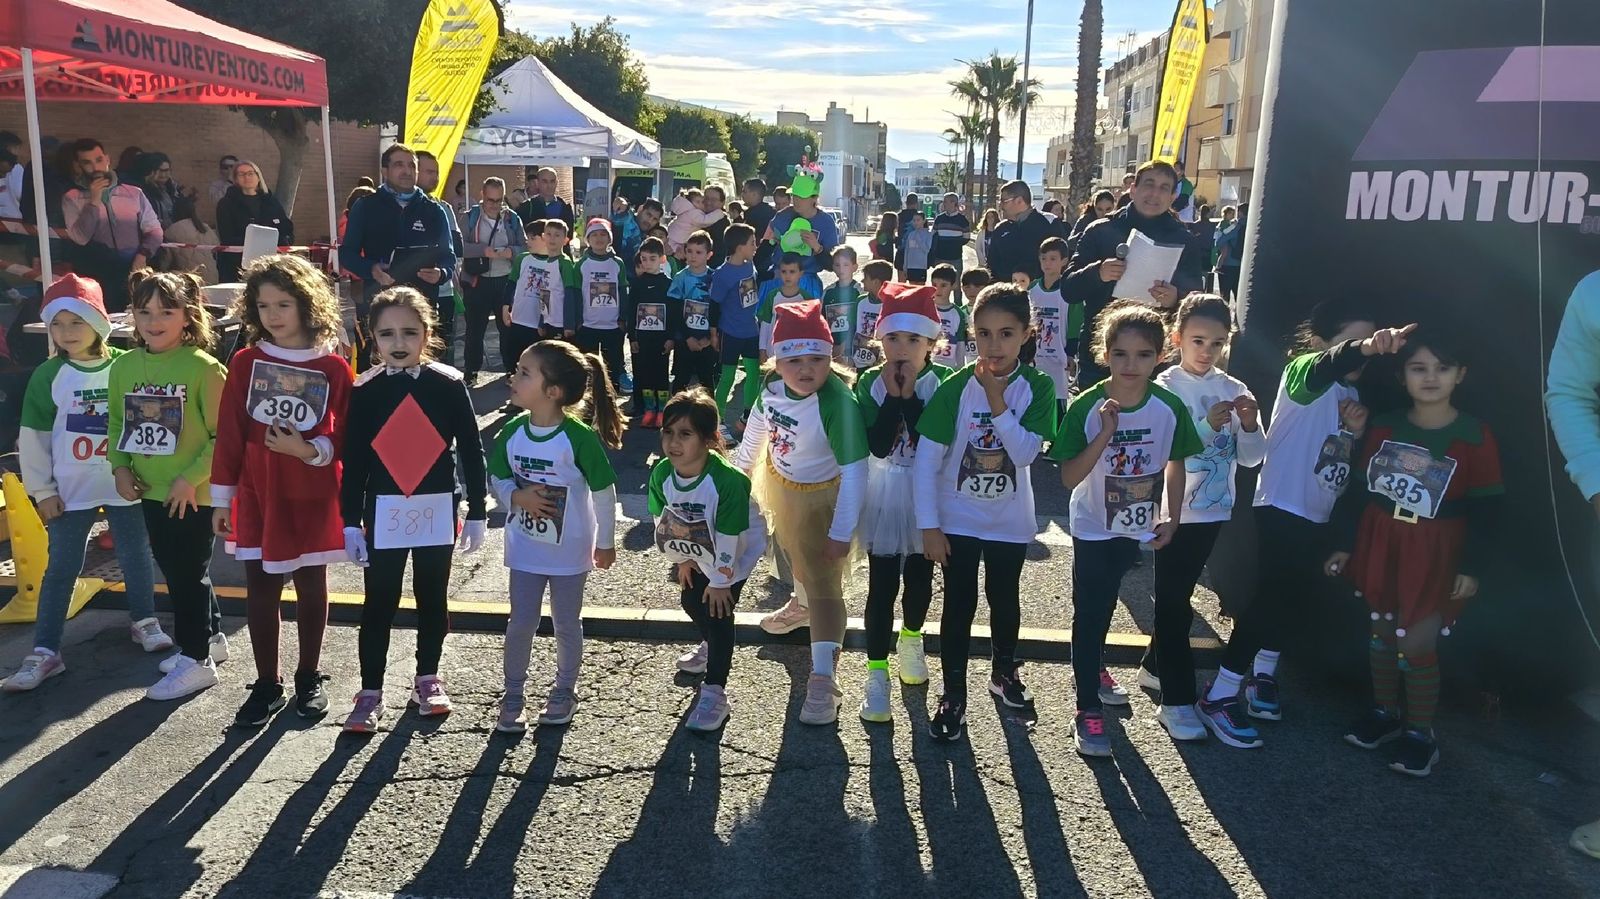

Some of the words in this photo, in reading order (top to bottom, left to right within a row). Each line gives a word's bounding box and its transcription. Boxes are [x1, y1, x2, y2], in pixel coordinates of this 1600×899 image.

[105, 24, 305, 93] MONTUREVENTOS.COM
[595, 296, 613, 304] 372
[642, 318, 659, 326] 394
[689, 315, 706, 326] 376
[264, 397, 307, 422] 390
[135, 426, 168, 446] 382
[969, 475, 1007, 493] 379
[1382, 473, 1424, 503] 385
[387, 507, 434, 535] 389
[1121, 503, 1154, 526] 381
[669, 540, 703, 557] 400
